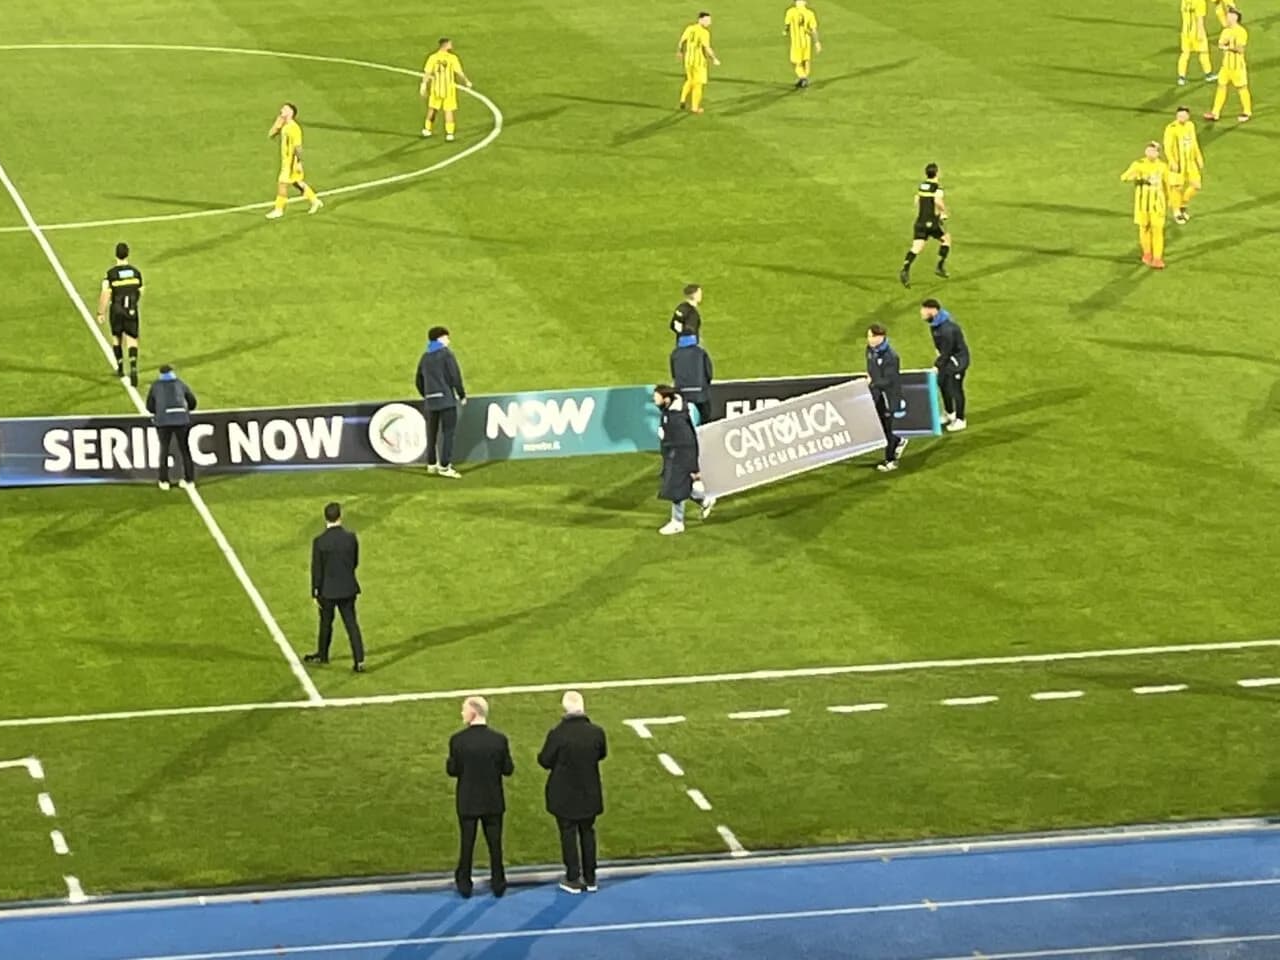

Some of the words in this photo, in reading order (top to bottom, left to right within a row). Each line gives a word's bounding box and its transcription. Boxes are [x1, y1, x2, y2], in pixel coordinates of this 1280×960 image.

[188, 423, 218, 466] C
[228, 416, 343, 464] NOW
[486, 397, 595, 439] NOW
[724, 400, 846, 458] CATTOLICA
[735, 430, 852, 478] ASSICURAZIONI
